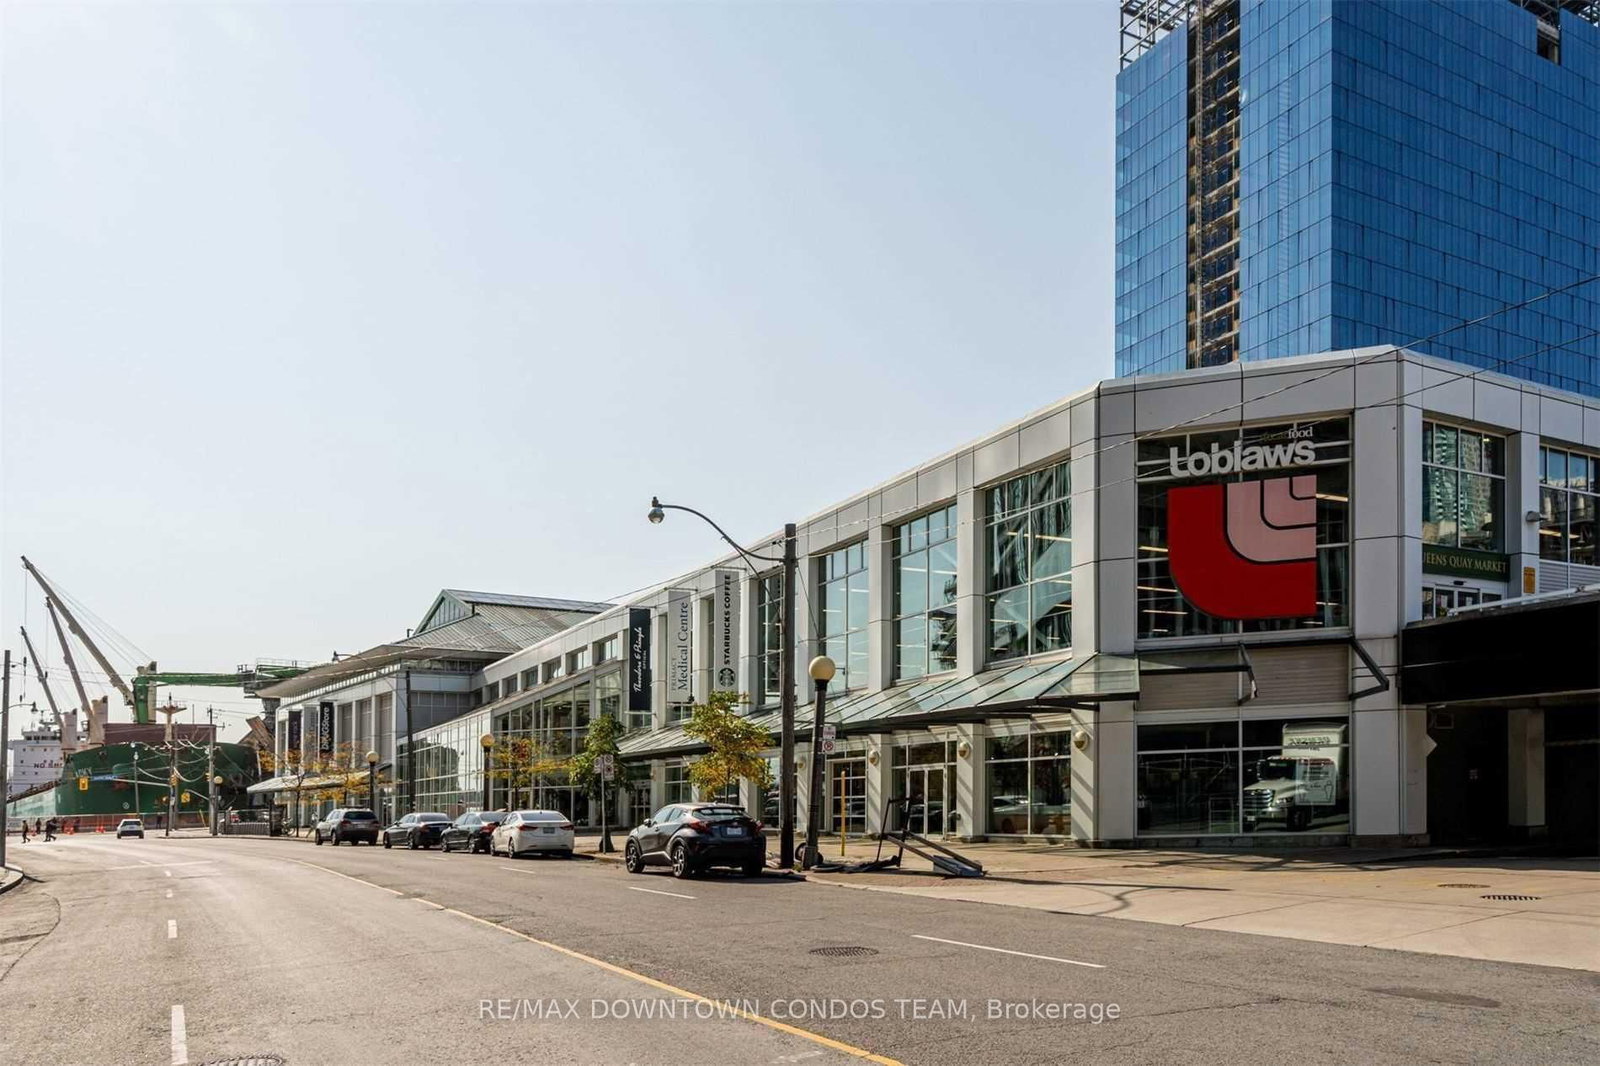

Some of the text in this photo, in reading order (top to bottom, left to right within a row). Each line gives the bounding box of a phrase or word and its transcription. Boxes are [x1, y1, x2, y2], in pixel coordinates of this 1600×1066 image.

[1287, 426, 1313, 439] food
[1449, 555, 1473, 570] QUAY
[1474, 560, 1507, 573] MARKET
[677, 602, 688, 691] Medical Centre
